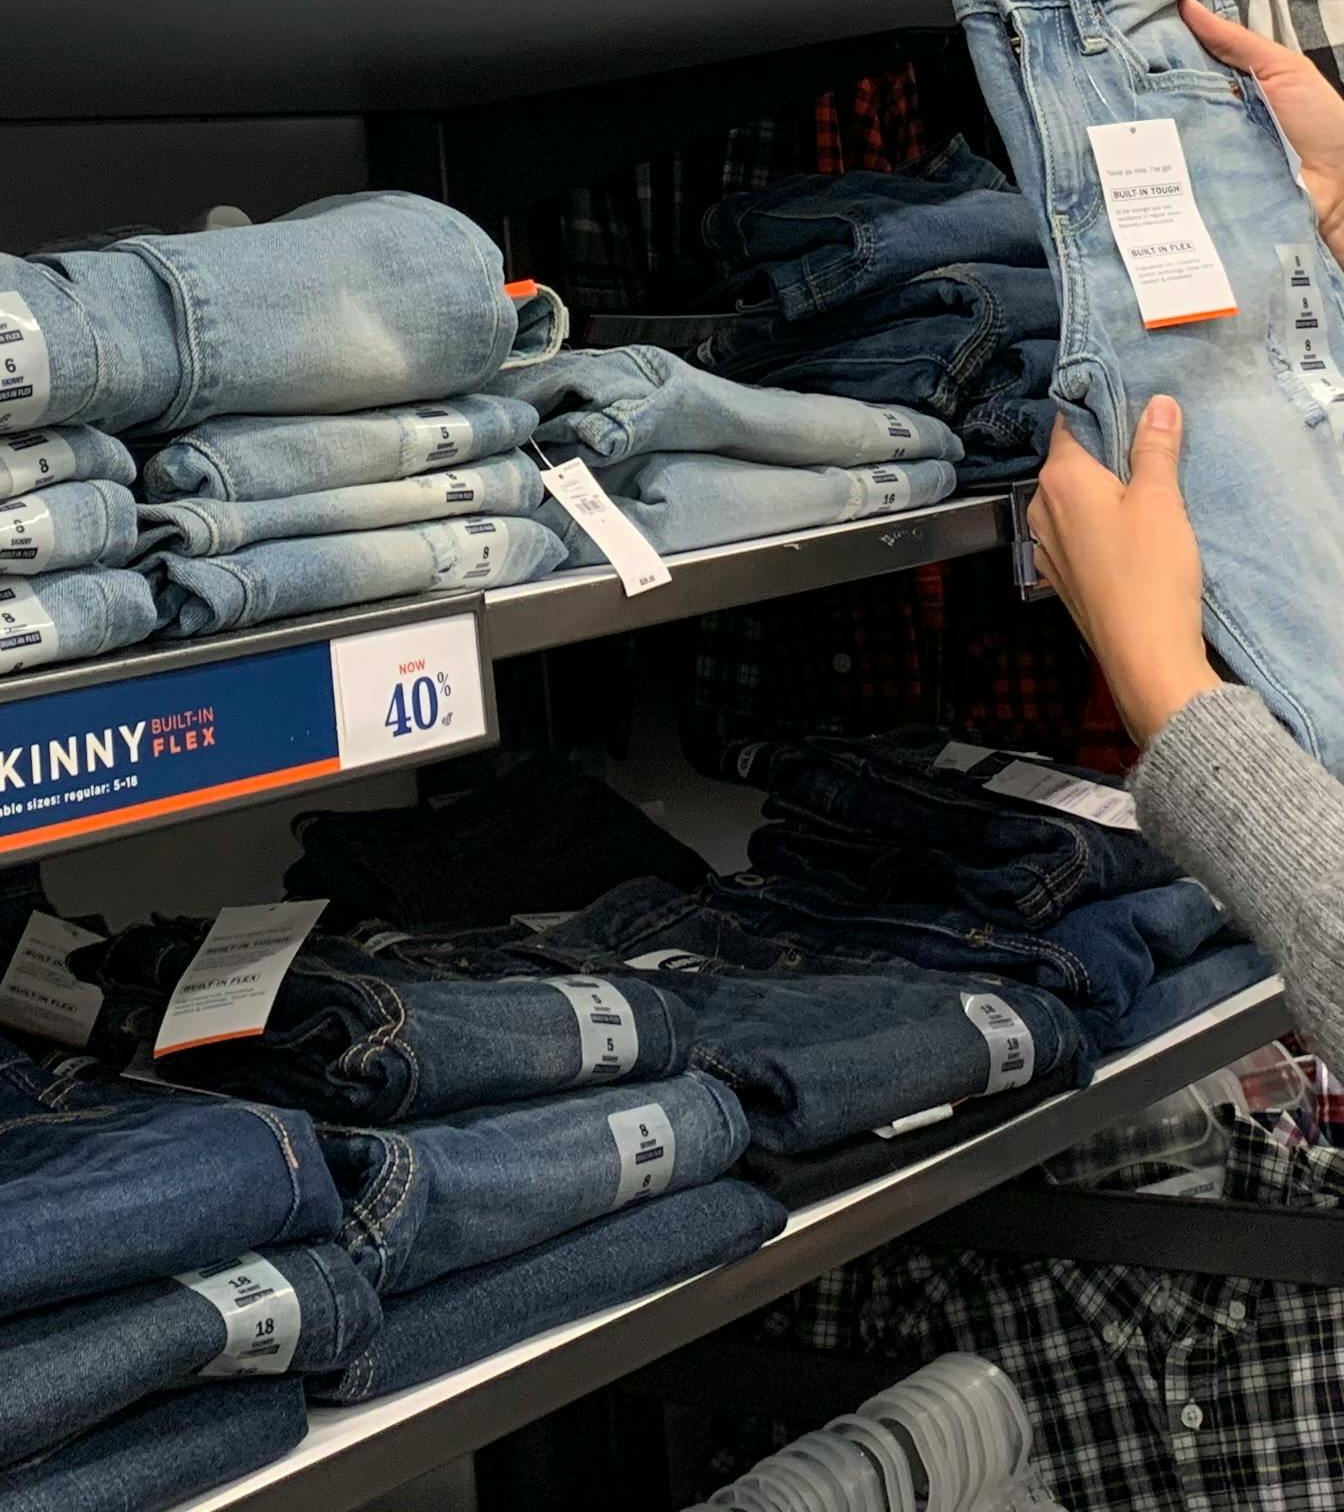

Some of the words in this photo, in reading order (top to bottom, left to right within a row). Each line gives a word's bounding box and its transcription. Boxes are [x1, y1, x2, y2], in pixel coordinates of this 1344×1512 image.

[1150, 186, 1181, 195] TOUGH
[1169, 243, 1192, 251] FLEX
[1305, 339, 1311, 351] 8
[5, 358, 16, 373] 6
[2, 376, 24, 386] SKINNY
[441, 426, 450, 440] 5
[39, 458, 49, 473] 8
[482, 545, 490, 559] 8
[2, 613, 15, 623] 8
[399, 659, 425, 675] NOW
[151, 707, 214, 734] BUILT-IN
[152, 727, 215, 758] FLEX
[27, 794, 60, 811] sizes:
[64, 782, 110, 803] regular:
[607, 1038, 614, 1051] 5
[639, 1124, 648, 1137] 8
[228, 1276, 251, 1288] 18
[256, 1318, 274, 1336] 18
